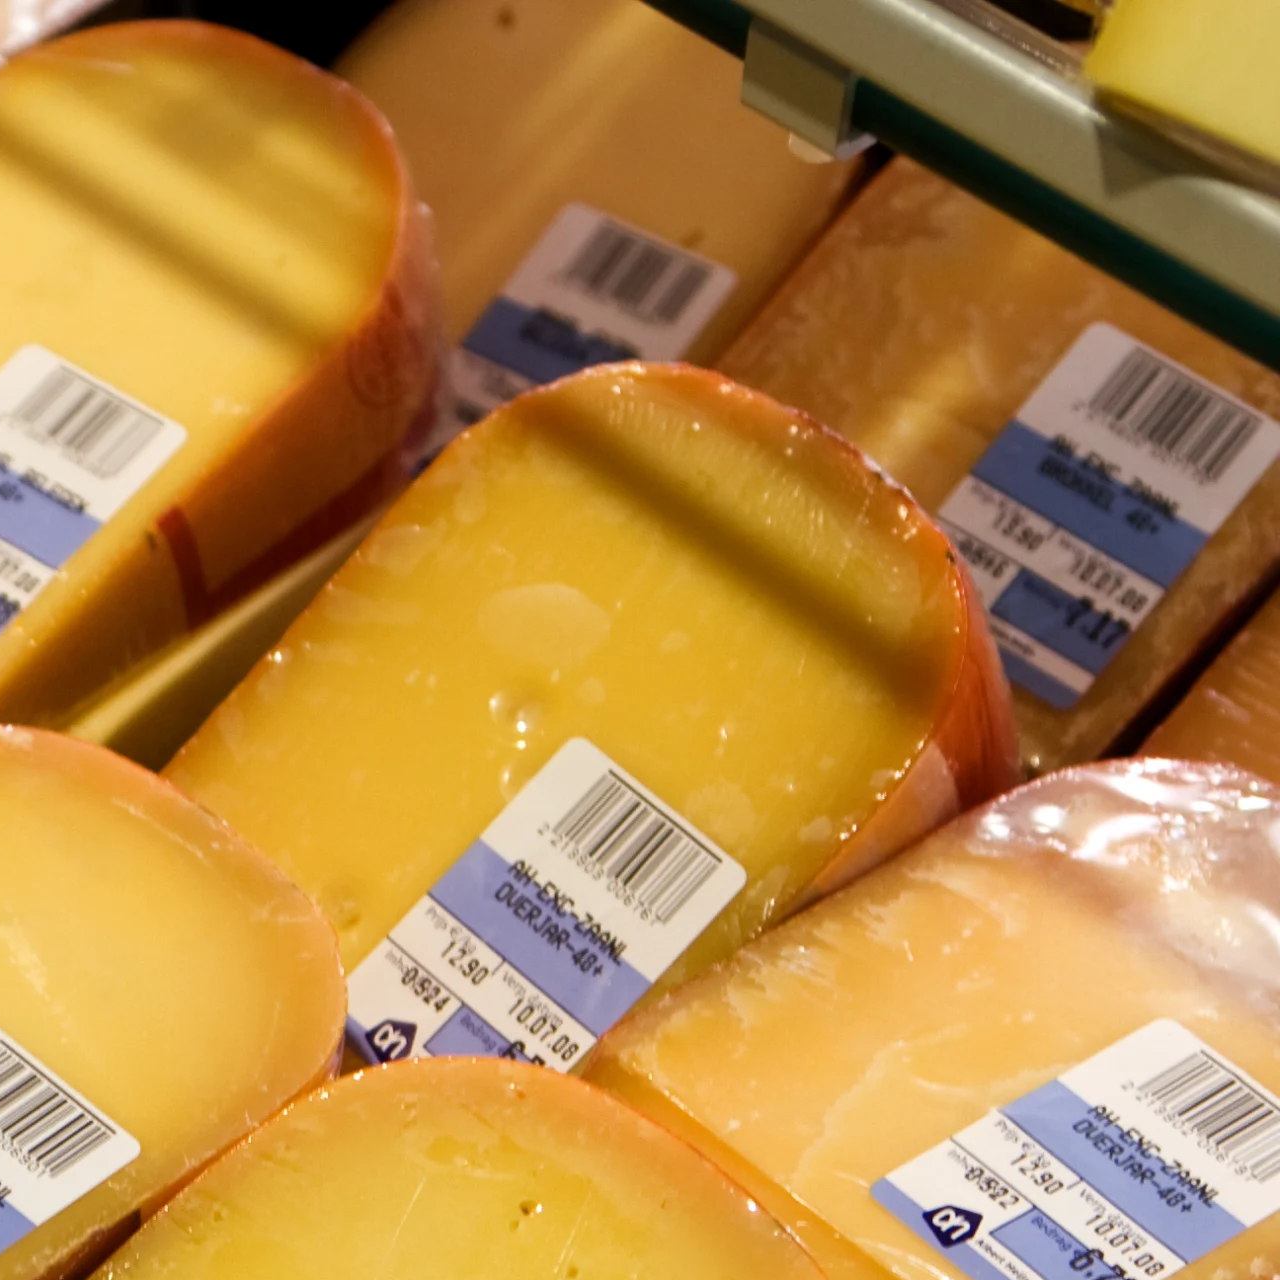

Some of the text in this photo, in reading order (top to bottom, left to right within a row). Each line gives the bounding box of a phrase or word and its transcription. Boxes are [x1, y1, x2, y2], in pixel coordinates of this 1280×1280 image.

[493, 882, 605, 982] OVERJAR-48+
[506, 860, 630, 967] AH-EXC-ZAANL
[435, 939, 497, 986] 12.90
[500, 996, 585, 1062] 10.07.08
[1008, 1151, 1069, 1195] 12.90
[1070, 1117, 1196, 1215] OVERJAR-48+
[1086, 1102, 1222, 1209] AH-EXC-ZAANL
[1082, 1212, 1166, 1277] 10.07.08
